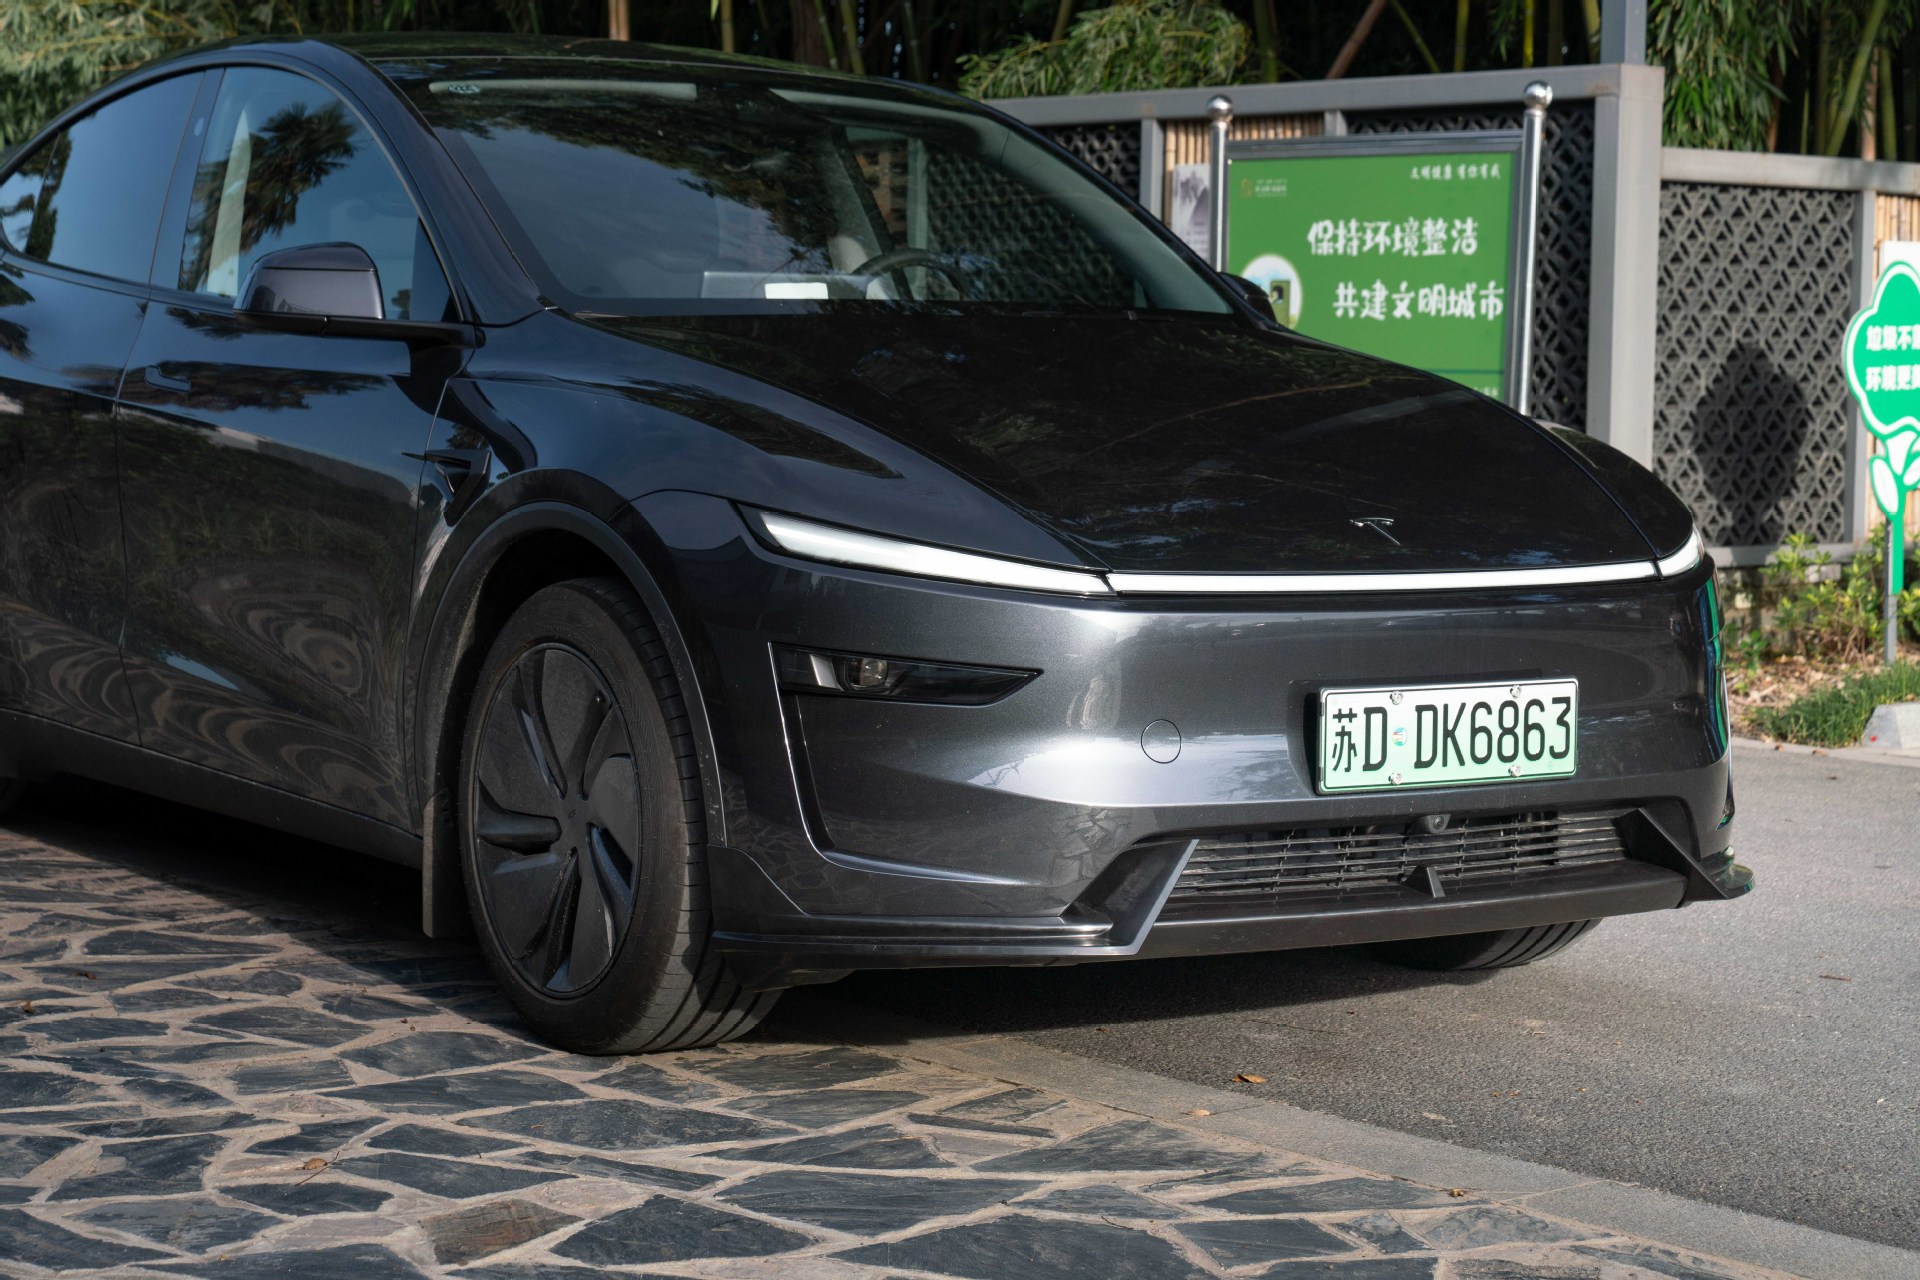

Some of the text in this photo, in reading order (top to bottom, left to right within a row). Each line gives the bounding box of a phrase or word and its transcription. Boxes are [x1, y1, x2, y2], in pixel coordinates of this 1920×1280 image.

[1307, 217, 1479, 257] 保持环境整洁
[1333, 279, 1504, 321] 共建文明城市
[1332, 696, 1571, 773] 苏D DK6863
